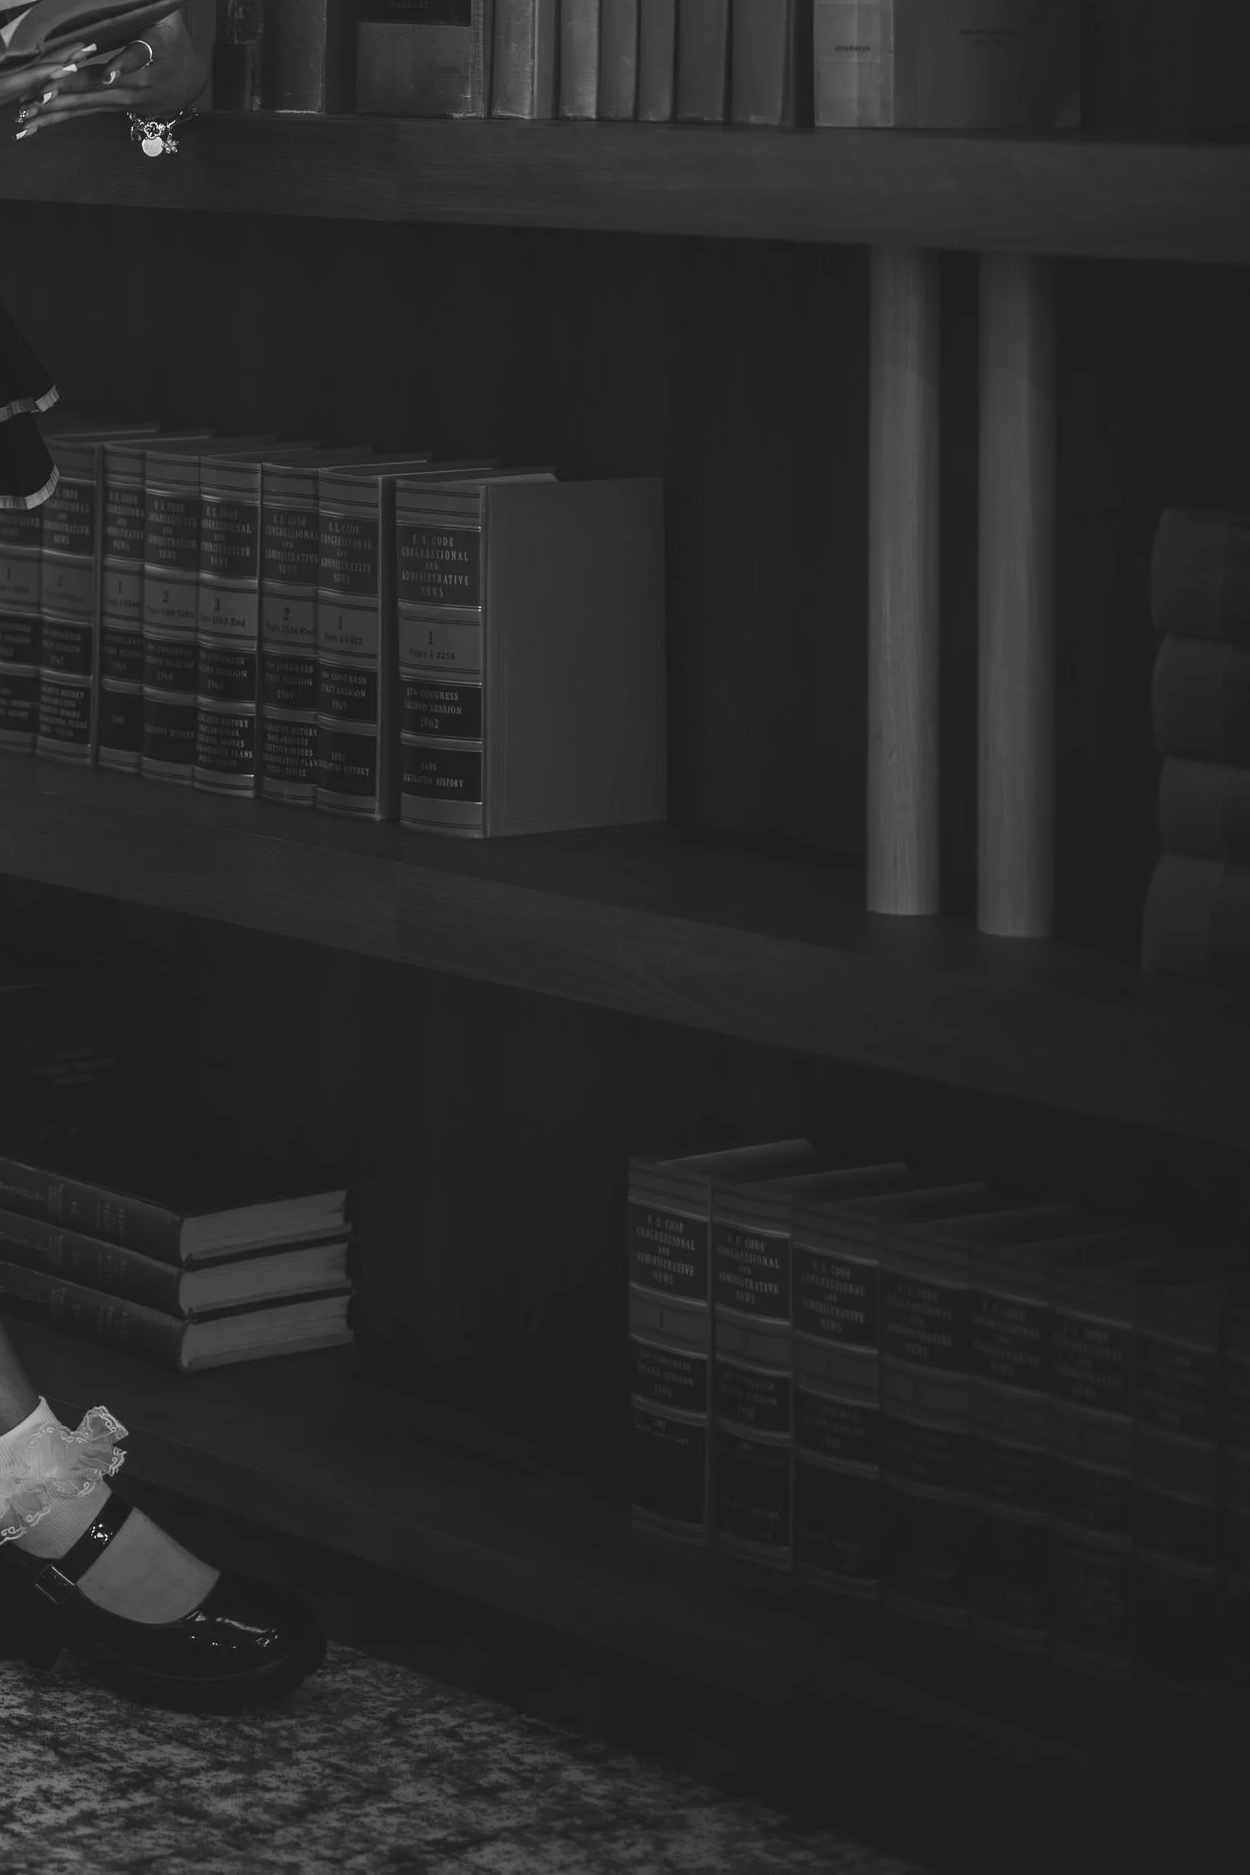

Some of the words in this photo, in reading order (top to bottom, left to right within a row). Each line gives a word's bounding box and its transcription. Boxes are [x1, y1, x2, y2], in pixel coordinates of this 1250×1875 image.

[432, 536, 454, 547] CODE
[401, 546, 469, 562] CONGRESSIONAL
[402, 570, 469, 586] ADMINISTRATIVE
[214, 598, 221, 611] 3
[283, 607, 290, 621] 2
[428, 630, 433, 645] 1
[409, 647, 427, 658] Pages
[420, 689, 459, 701] CONGRESS
[430, 704, 462, 715] SESSION
[420, 716, 438, 729] 1962
[436, 777, 464, 788] HISTORY
[665, 1219, 684, 1234] CODE
[636, 1226, 696, 1251] CONGRESSIONAL
[636, 1251, 696, 1276] ADMINISTRATIVE
[717, 1244, 780, 1270] CONGRESSIONAL
[653, 1271, 674, 1285] NEWS
[718, 1270, 779, 1295] ADMINISTRATIVE
